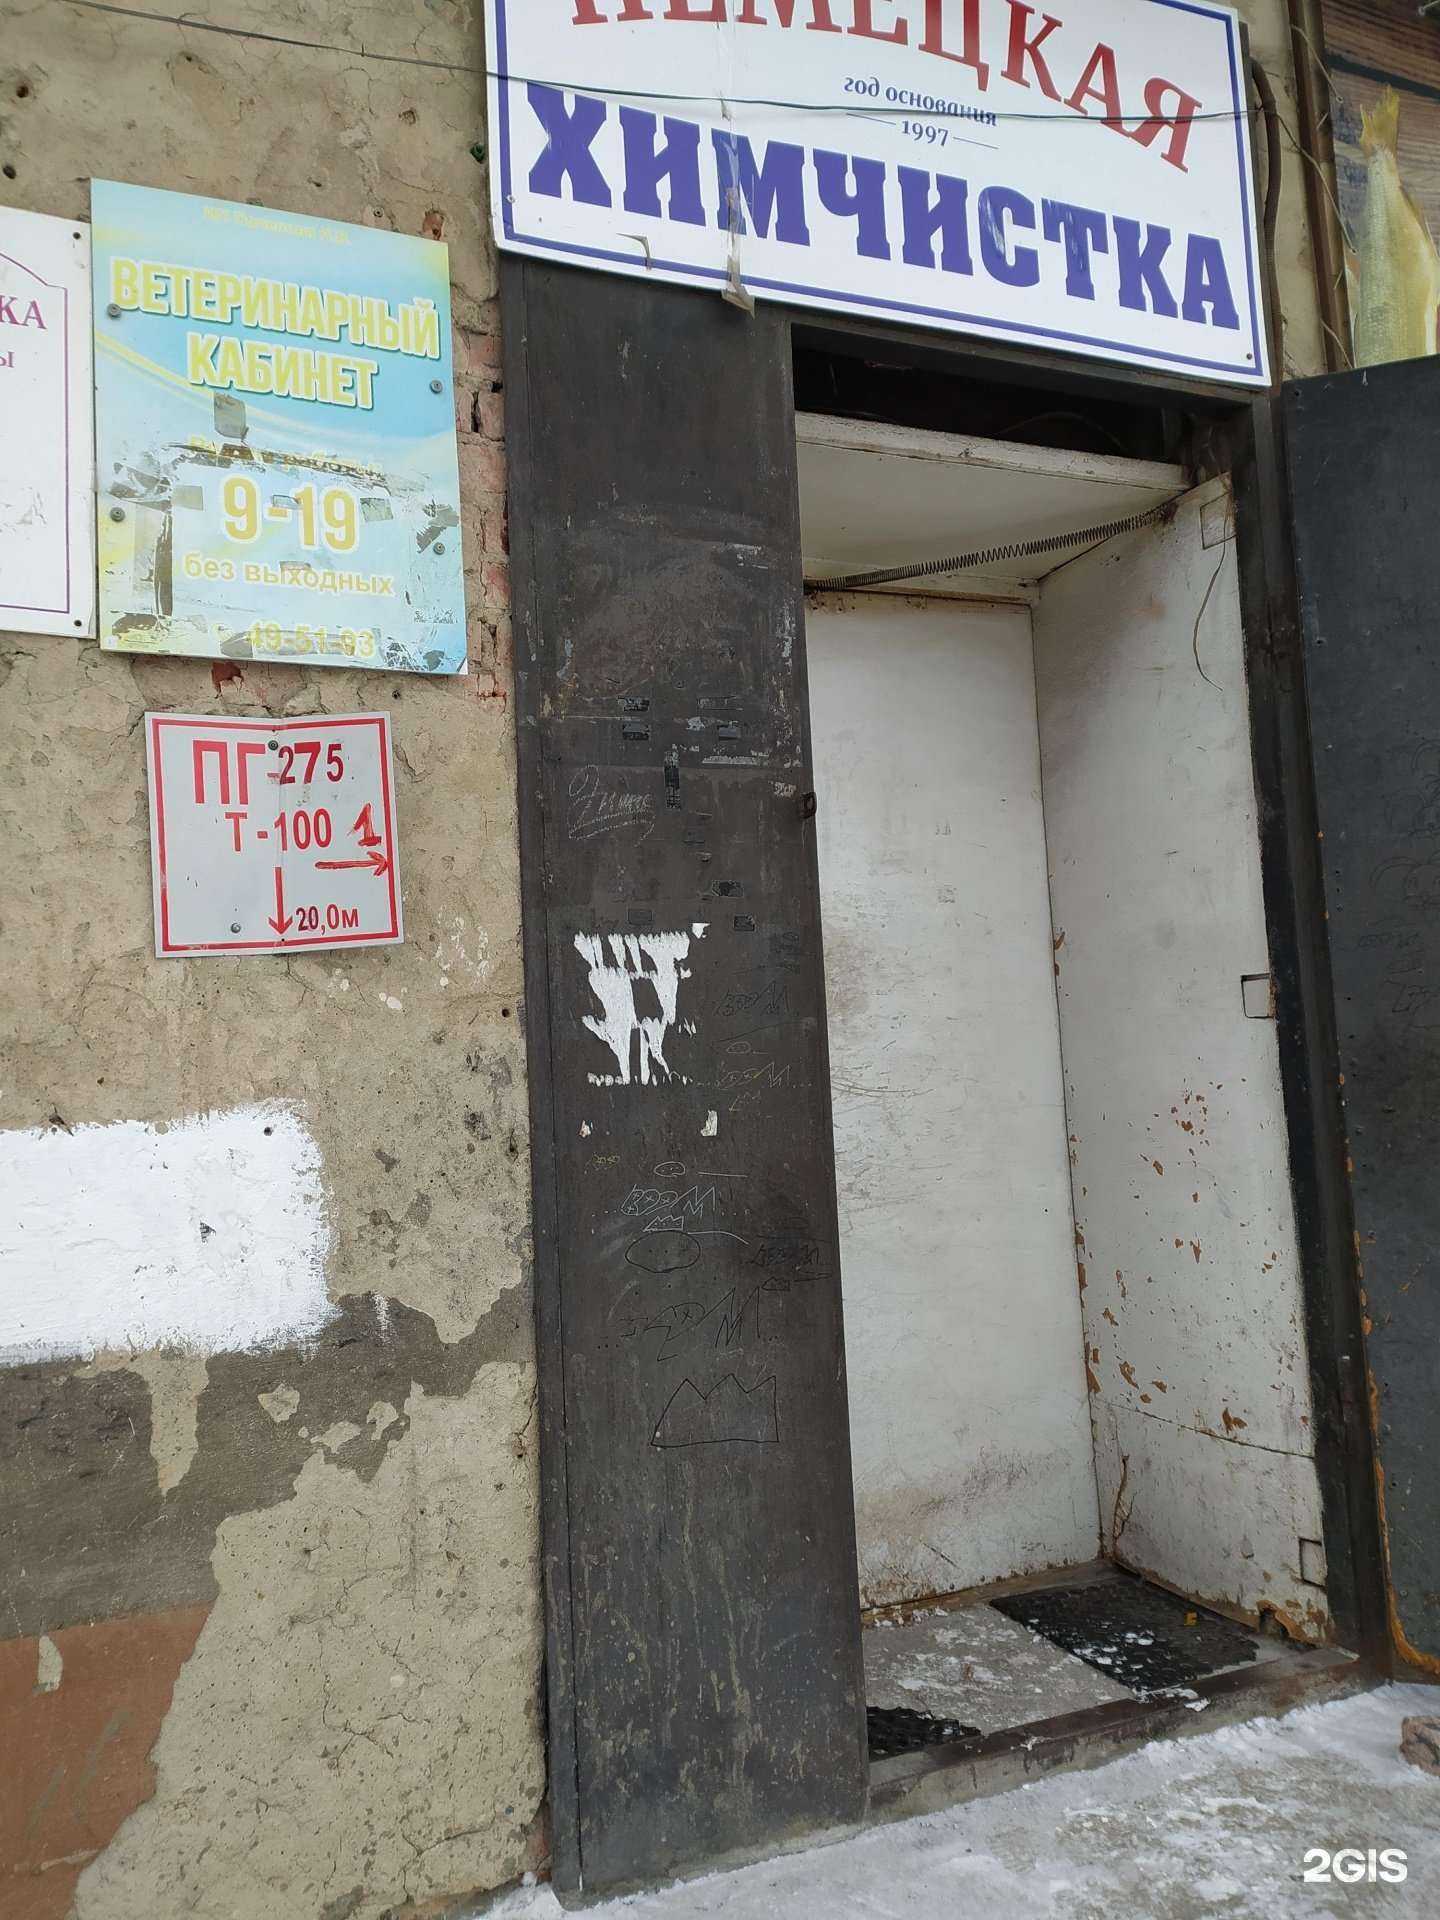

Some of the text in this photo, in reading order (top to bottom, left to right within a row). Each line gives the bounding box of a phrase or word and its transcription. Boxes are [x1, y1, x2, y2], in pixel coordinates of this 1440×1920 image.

[572, 0, 1203, 173] ЕЦКАЯ
[844, 77, 997, 126] год основания
[902, 120, 949, 146] 1997
[526, 81, 1241, 331] ХИМЧИСТКА
[110, 256, 441, 360] ВЕТЕРИНАРНЫЙ
[186, 331, 380, 410] КАБИНЕТ
[221, 474, 360, 553] 9-19
[184, 551, 395, 597] без выходных
[350, 802, 382, 847] 1
[295, 903, 359, 936] 20,0м
